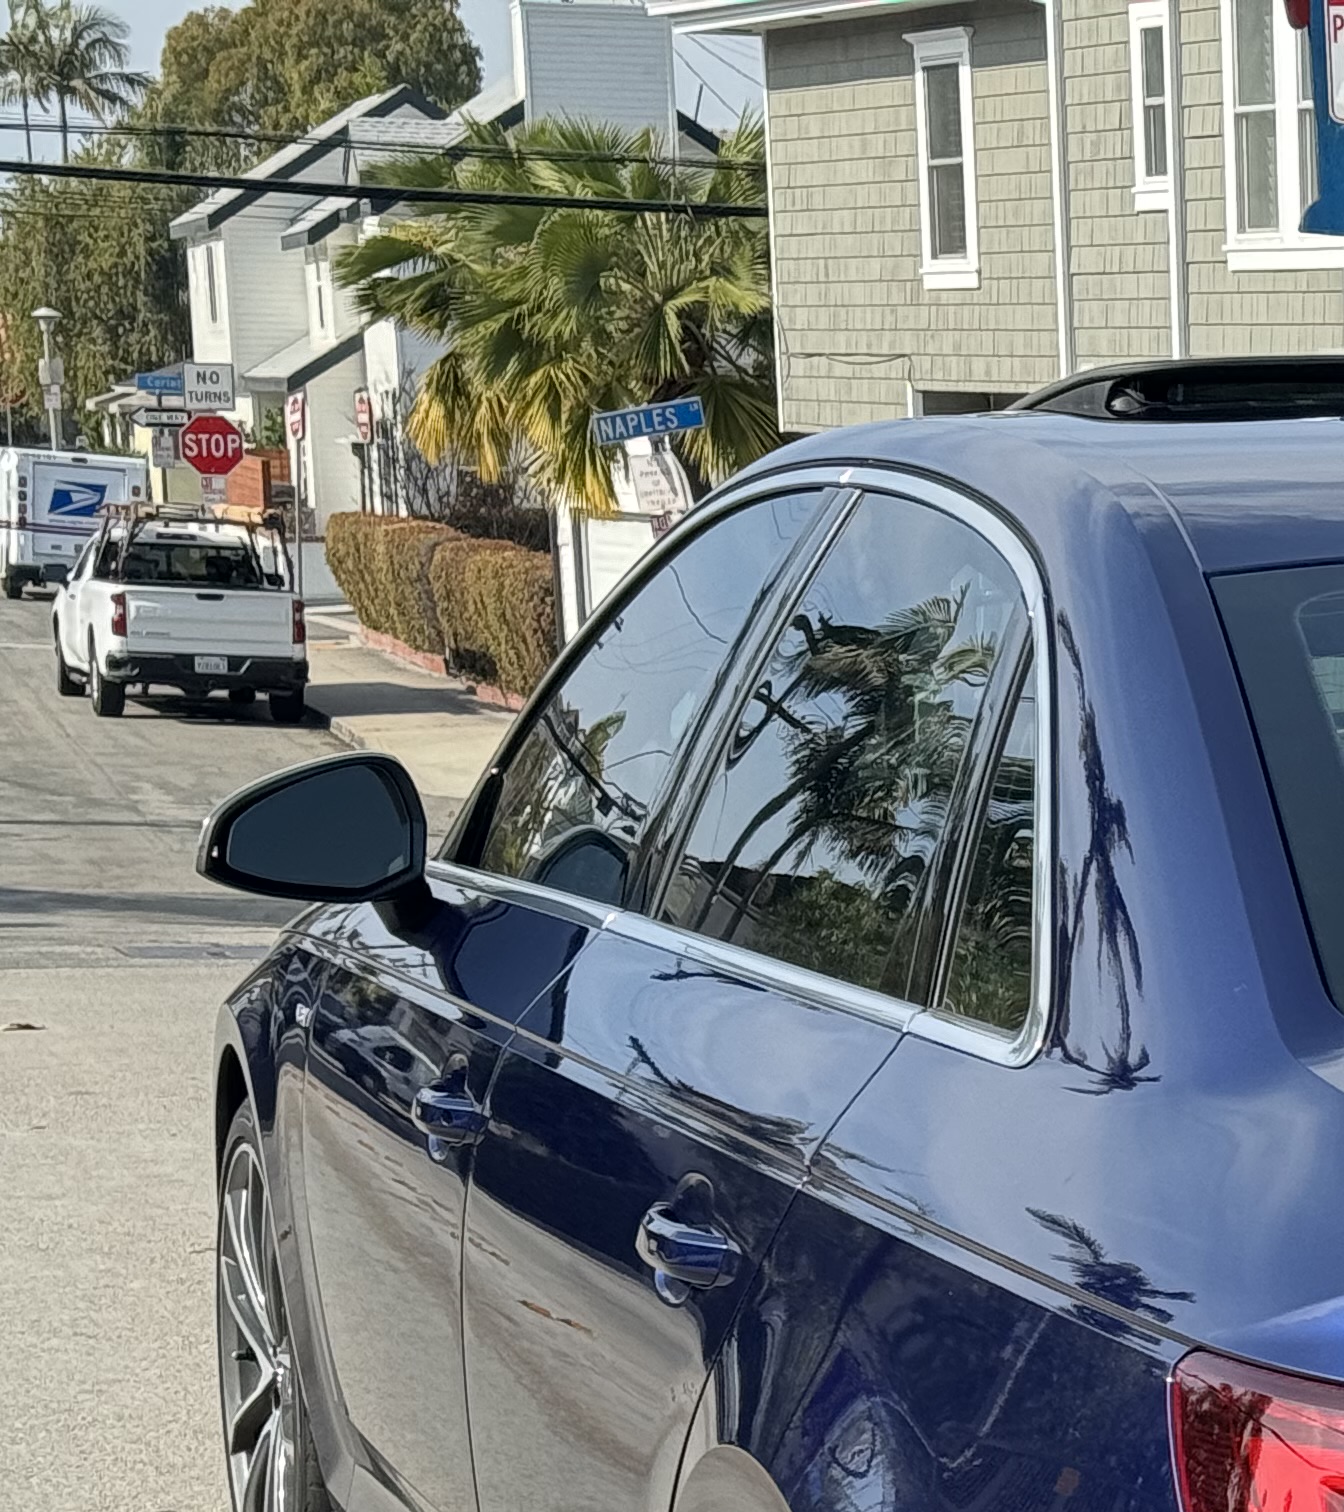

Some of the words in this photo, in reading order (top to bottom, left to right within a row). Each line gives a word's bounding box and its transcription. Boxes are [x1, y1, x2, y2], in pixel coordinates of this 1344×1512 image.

[196, 370, 220, 385] NO
[188, 390, 231, 403] TURNS
[600, 407, 678, 440] NAPLES
[184, 433, 241, 458] STOP
